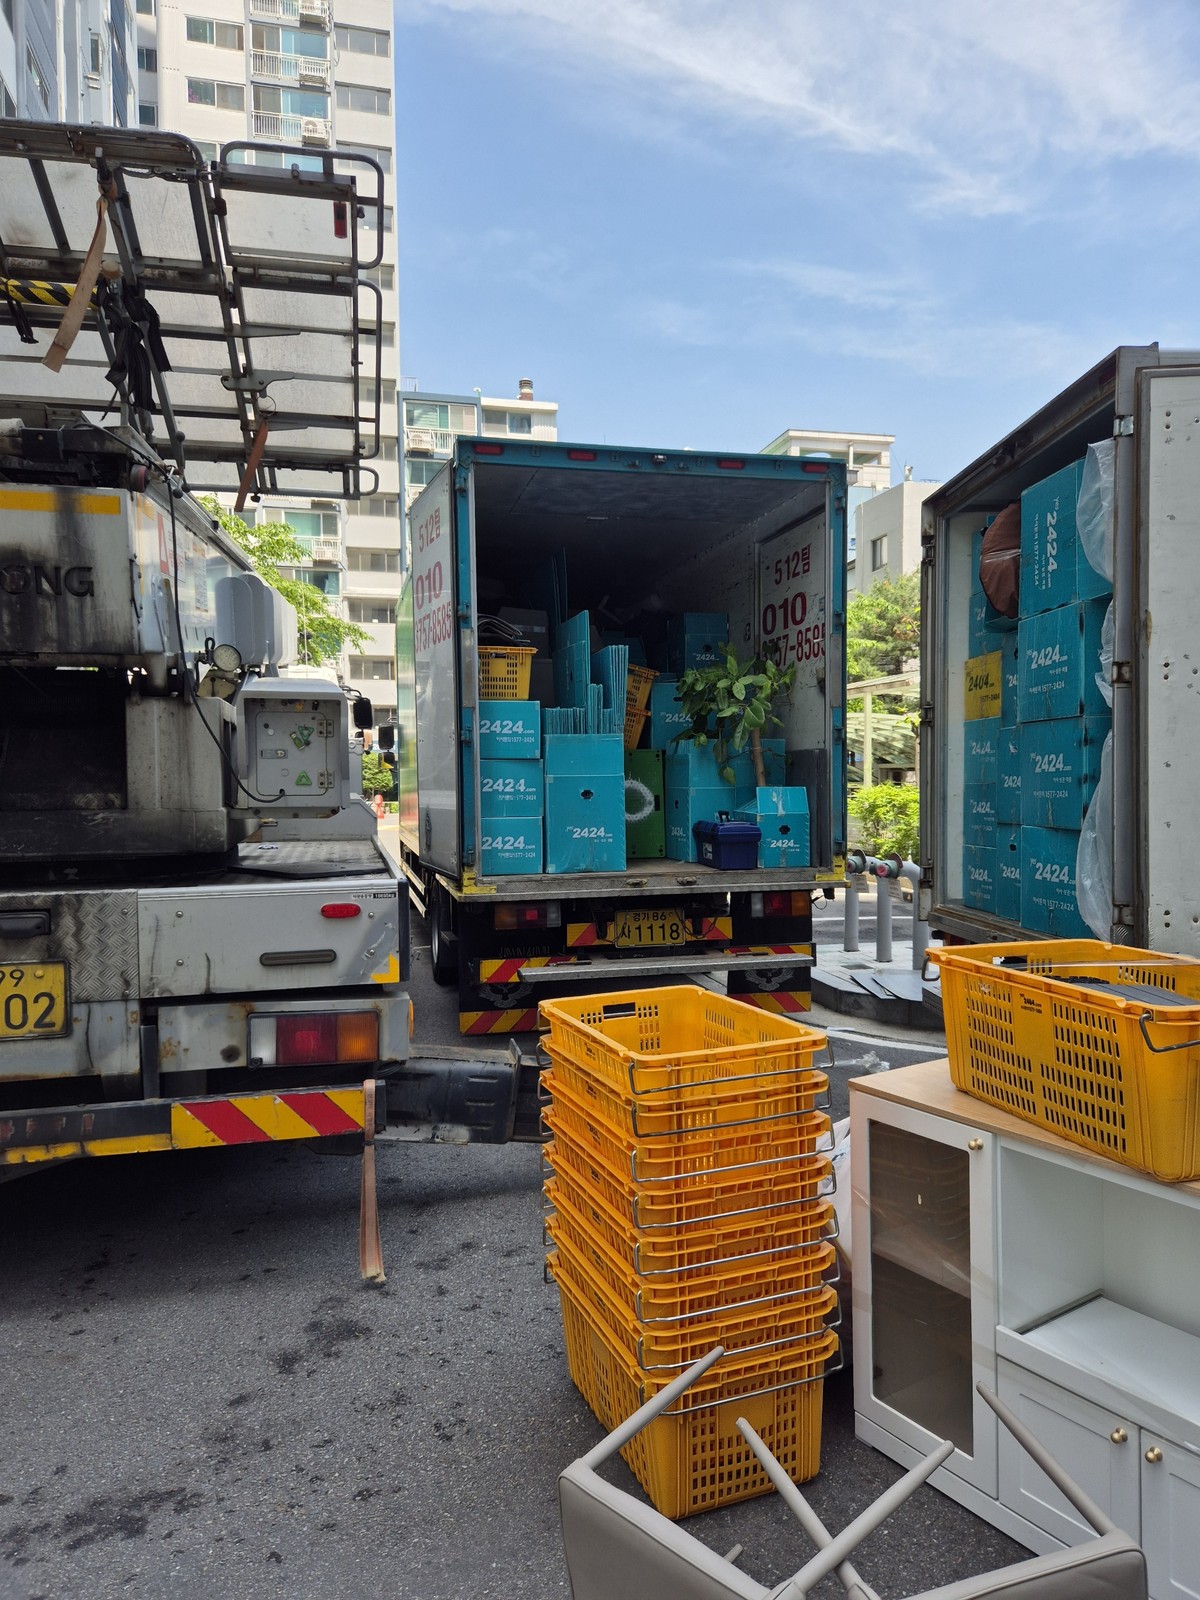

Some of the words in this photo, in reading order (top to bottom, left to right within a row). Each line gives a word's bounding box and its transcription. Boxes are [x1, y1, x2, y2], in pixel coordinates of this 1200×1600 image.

[415, 560, 443, 610] 010
[774, 543, 812, 586] 512팀
[762, 591, 808, 636] 010
[632, 912, 649, 922] 경기
[652, 911, 667, 922] 86
[635, 922, 680, 942] 1118
[4, 991, 56, 1031] 02
